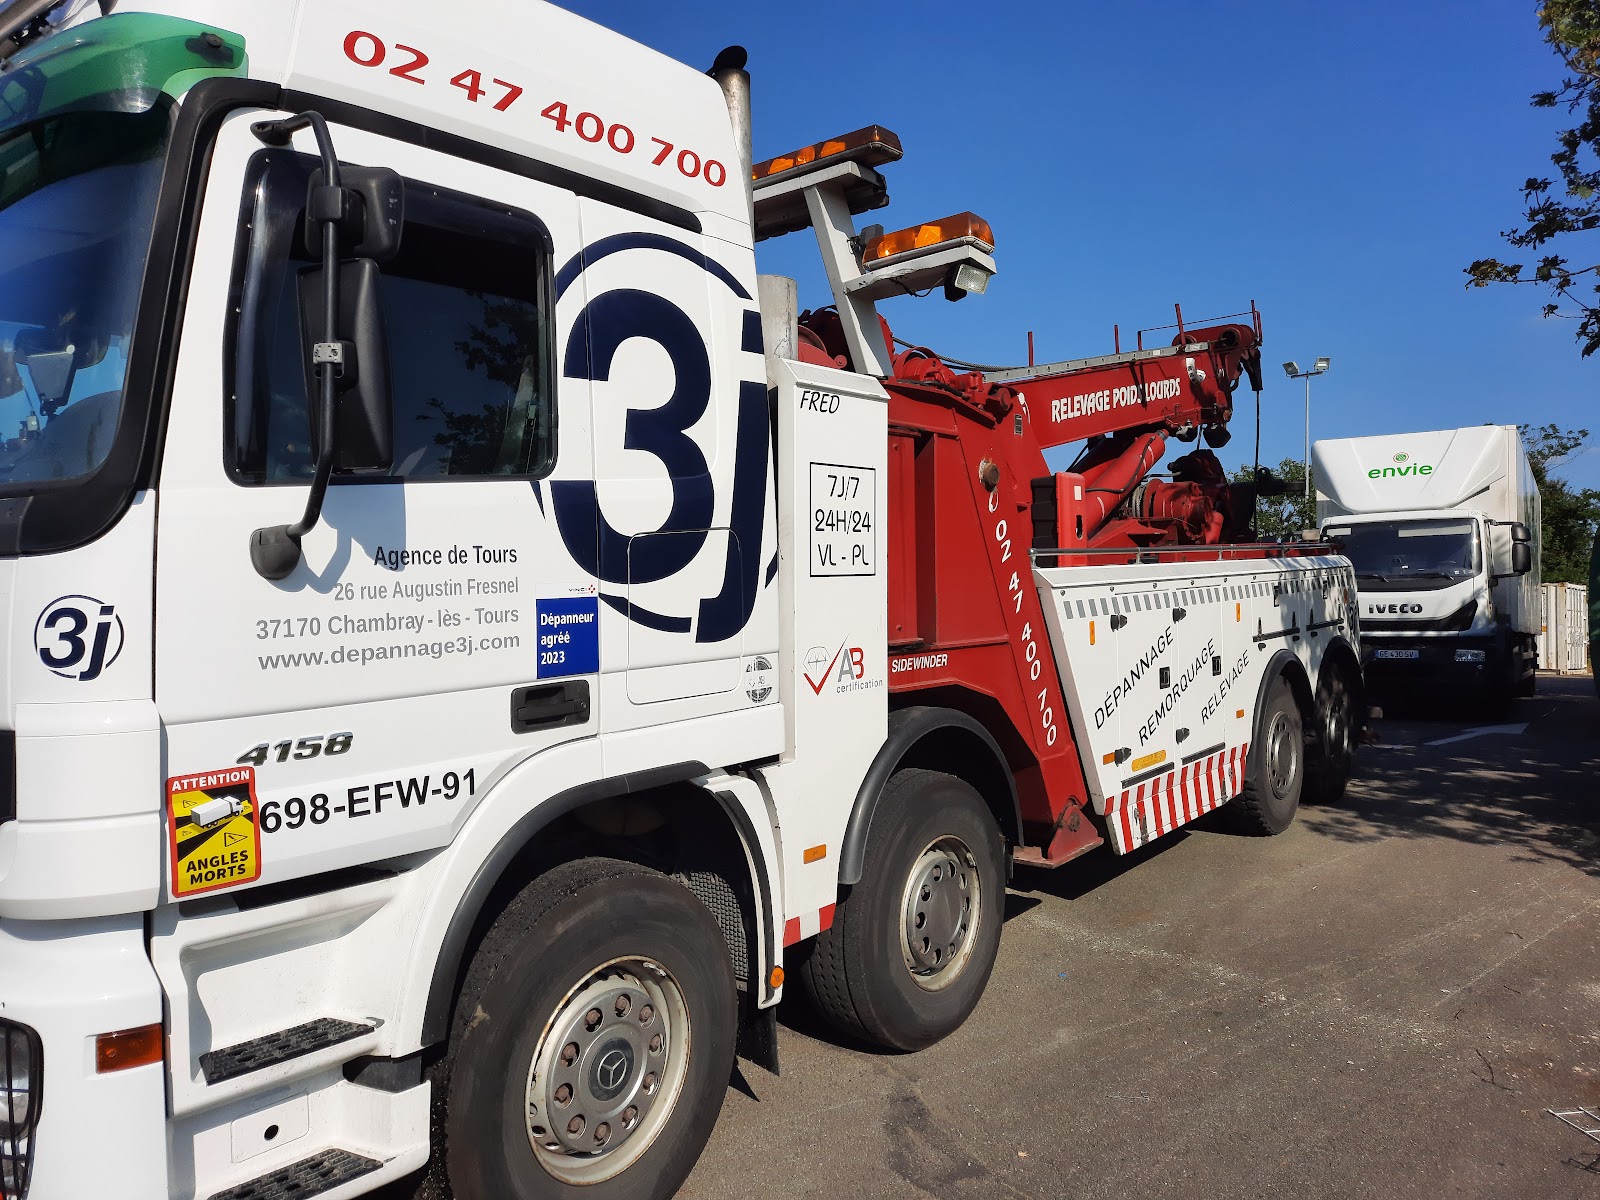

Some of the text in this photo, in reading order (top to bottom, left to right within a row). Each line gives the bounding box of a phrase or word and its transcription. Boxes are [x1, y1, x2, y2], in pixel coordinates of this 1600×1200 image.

[343, 30, 727, 187] 02 47 400 700
[800, 390, 840, 414] FRED
[1052, 389, 1110, 423] RELEVAGE
[1145, 377, 1181, 402] LOURDS
[550, 288, 771, 644] 3j
[1368, 463, 1433, 479] envie
[828, 475, 860, 500] 7J/7
[815, 509, 872, 534] 24H/24
[374, 545, 518, 570] Agence de Tours
[818, 544, 837, 566] VL
[852, 544, 869, 566] PL
[334, 577, 519, 602] 26 rue Augustin Fresnel
[540, 612, 595, 628] Dépanneur
[1368, 603, 1424, 615] IVECO
[255, 616, 321, 640] 37170
[474, 606, 519, 625] Tours
[40, 605, 115, 681] 3j
[258, 632, 521, 670] www.depannage3j.com
[540, 631, 571, 649] agréé
[540, 650, 566, 665] 2023
[837, 647, 865, 682] AB
[891, 653, 949, 673] SIDEWINDER
[836, 678, 883, 694] certification
[1094, 626, 1175, 730] DÉPANNAGE
[1200, 649, 1250, 725] RELEVAGE
[1138, 638, 1216, 747] REMORQUAGE
[236, 731, 353, 767] 4158
[171, 769, 250, 792] ATTENTION
[259, 767, 476, 834] 698-EFW-91
[186, 849, 249, 873] ANGLES
[190, 864, 246, 886] MORTS
